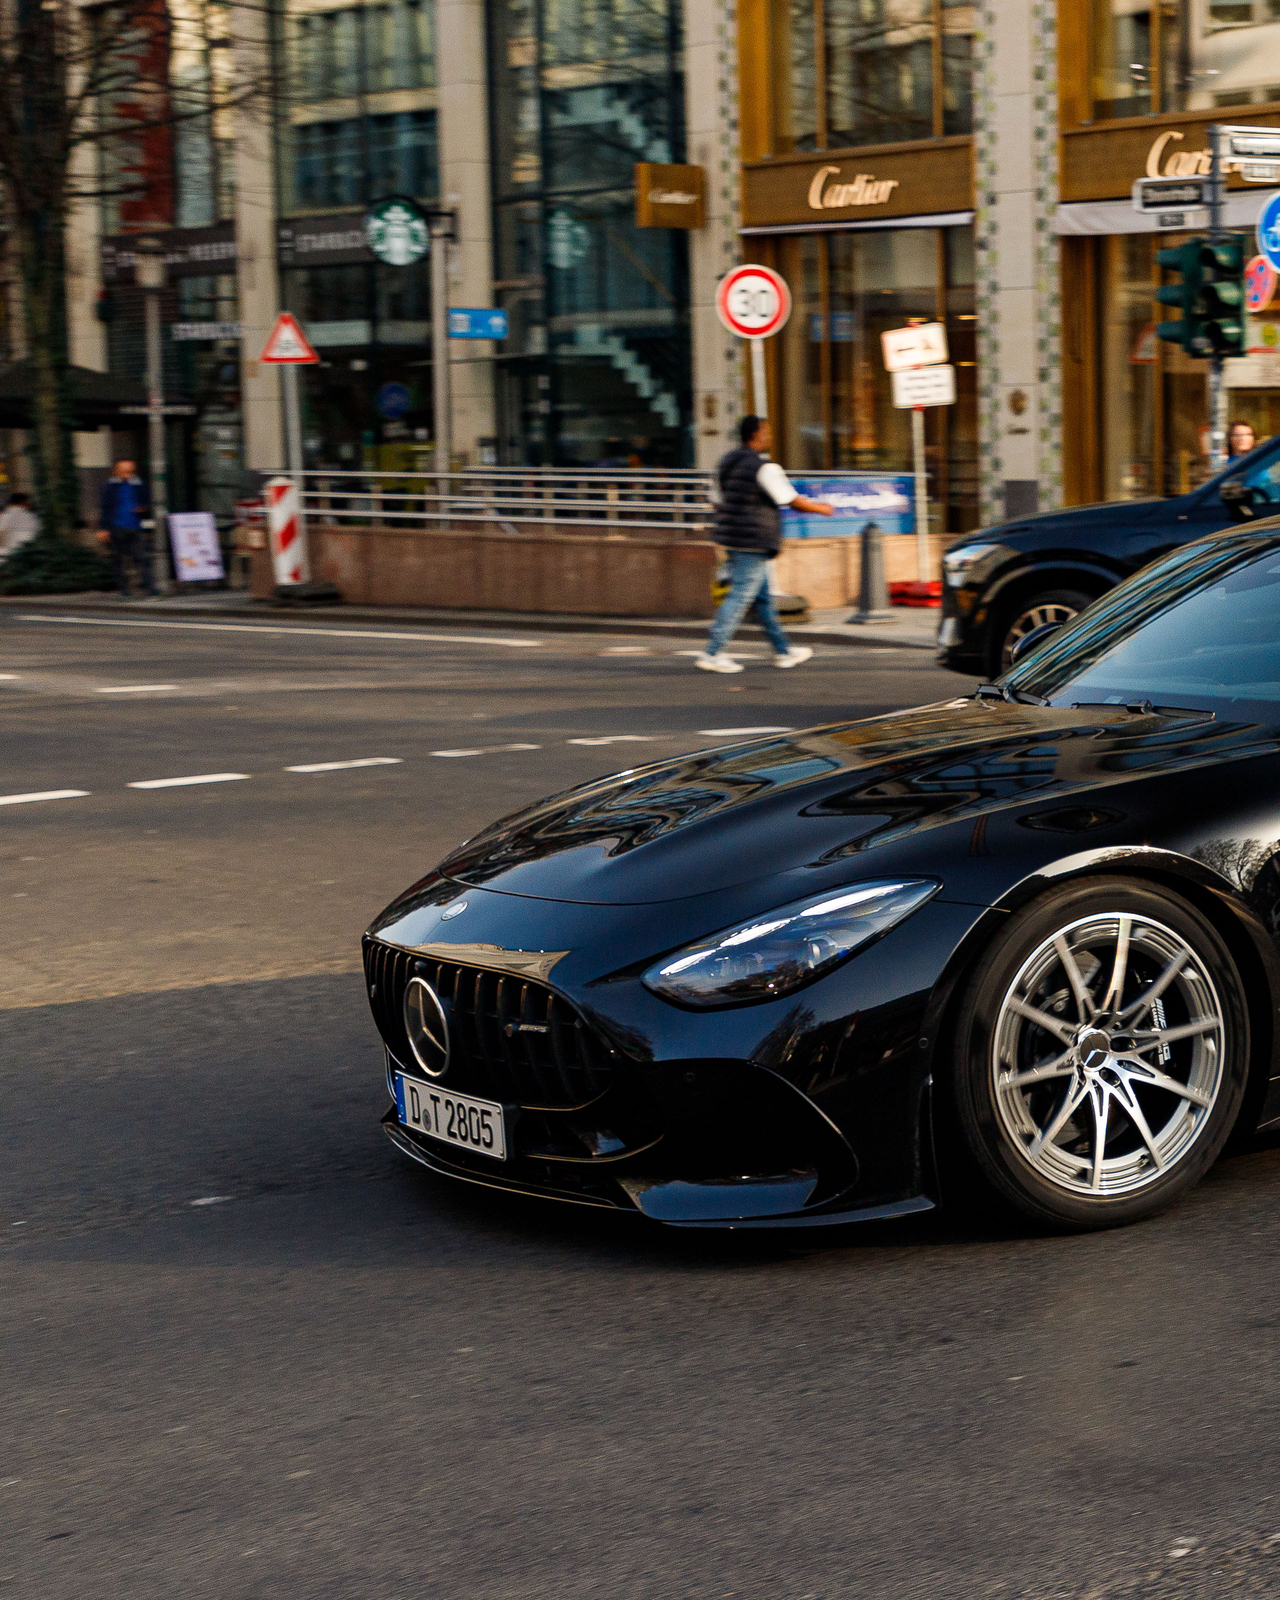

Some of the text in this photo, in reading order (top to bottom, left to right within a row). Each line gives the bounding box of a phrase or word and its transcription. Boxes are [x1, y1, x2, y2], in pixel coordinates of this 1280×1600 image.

[808, 166, 899, 209] Cartier
[736, 288, 774, 318] 30
[409, 1084, 494, 1149] D T 2805
